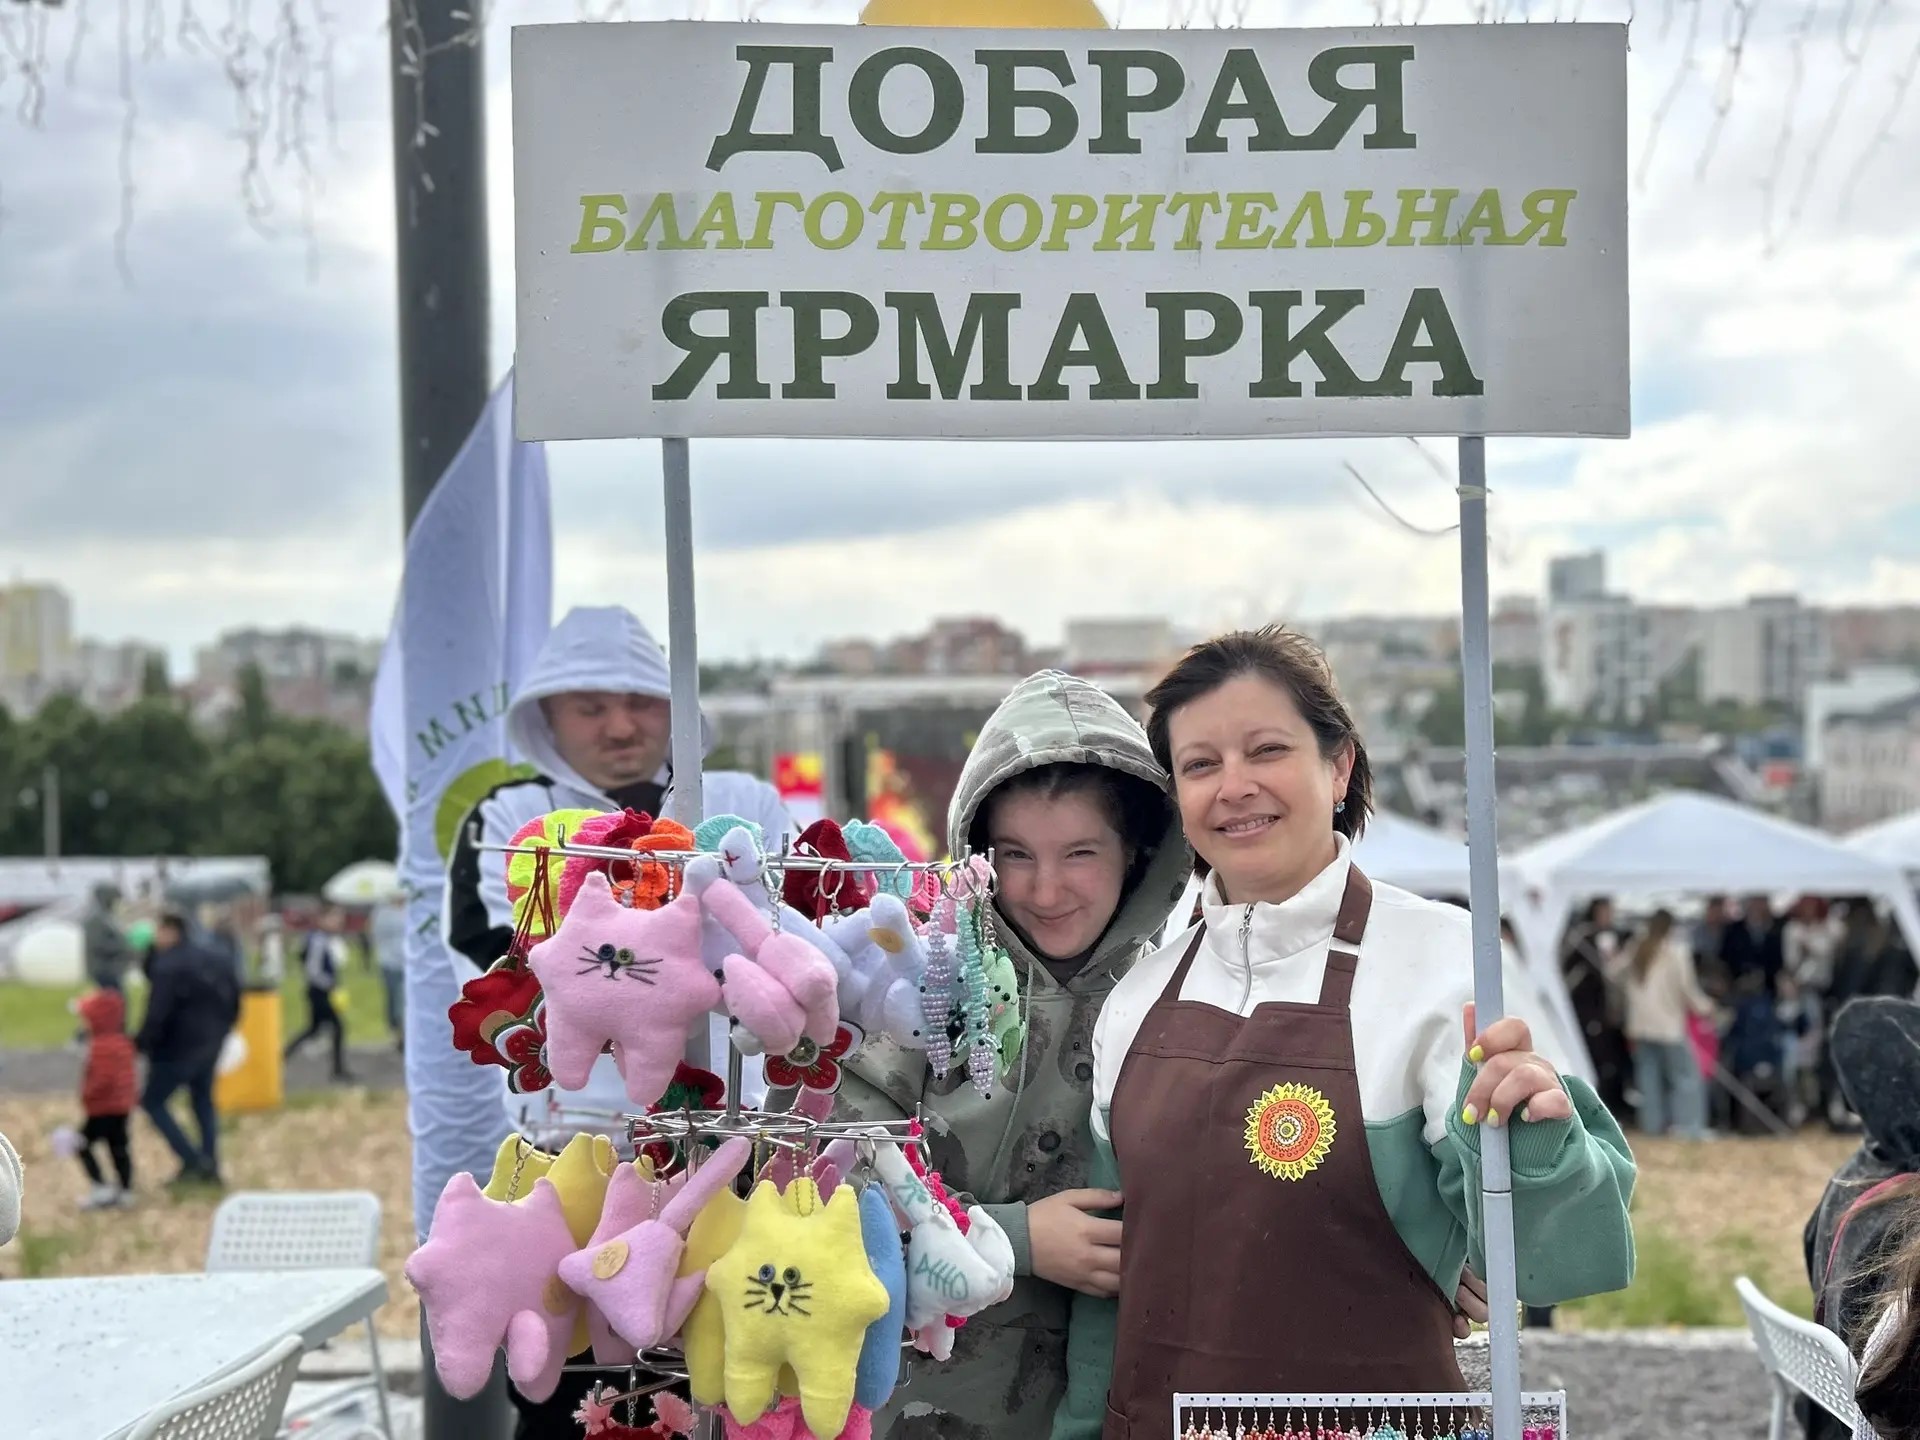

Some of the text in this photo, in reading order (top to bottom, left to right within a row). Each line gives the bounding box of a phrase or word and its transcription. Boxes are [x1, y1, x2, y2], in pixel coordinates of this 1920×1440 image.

[706, 46, 1417, 172] ДОБРАЯ
[571, 189, 1574, 252] БЛАГОТВОРИТЕЛЬНАЯ
[652, 288, 1484, 401] ЯРМАРКА
